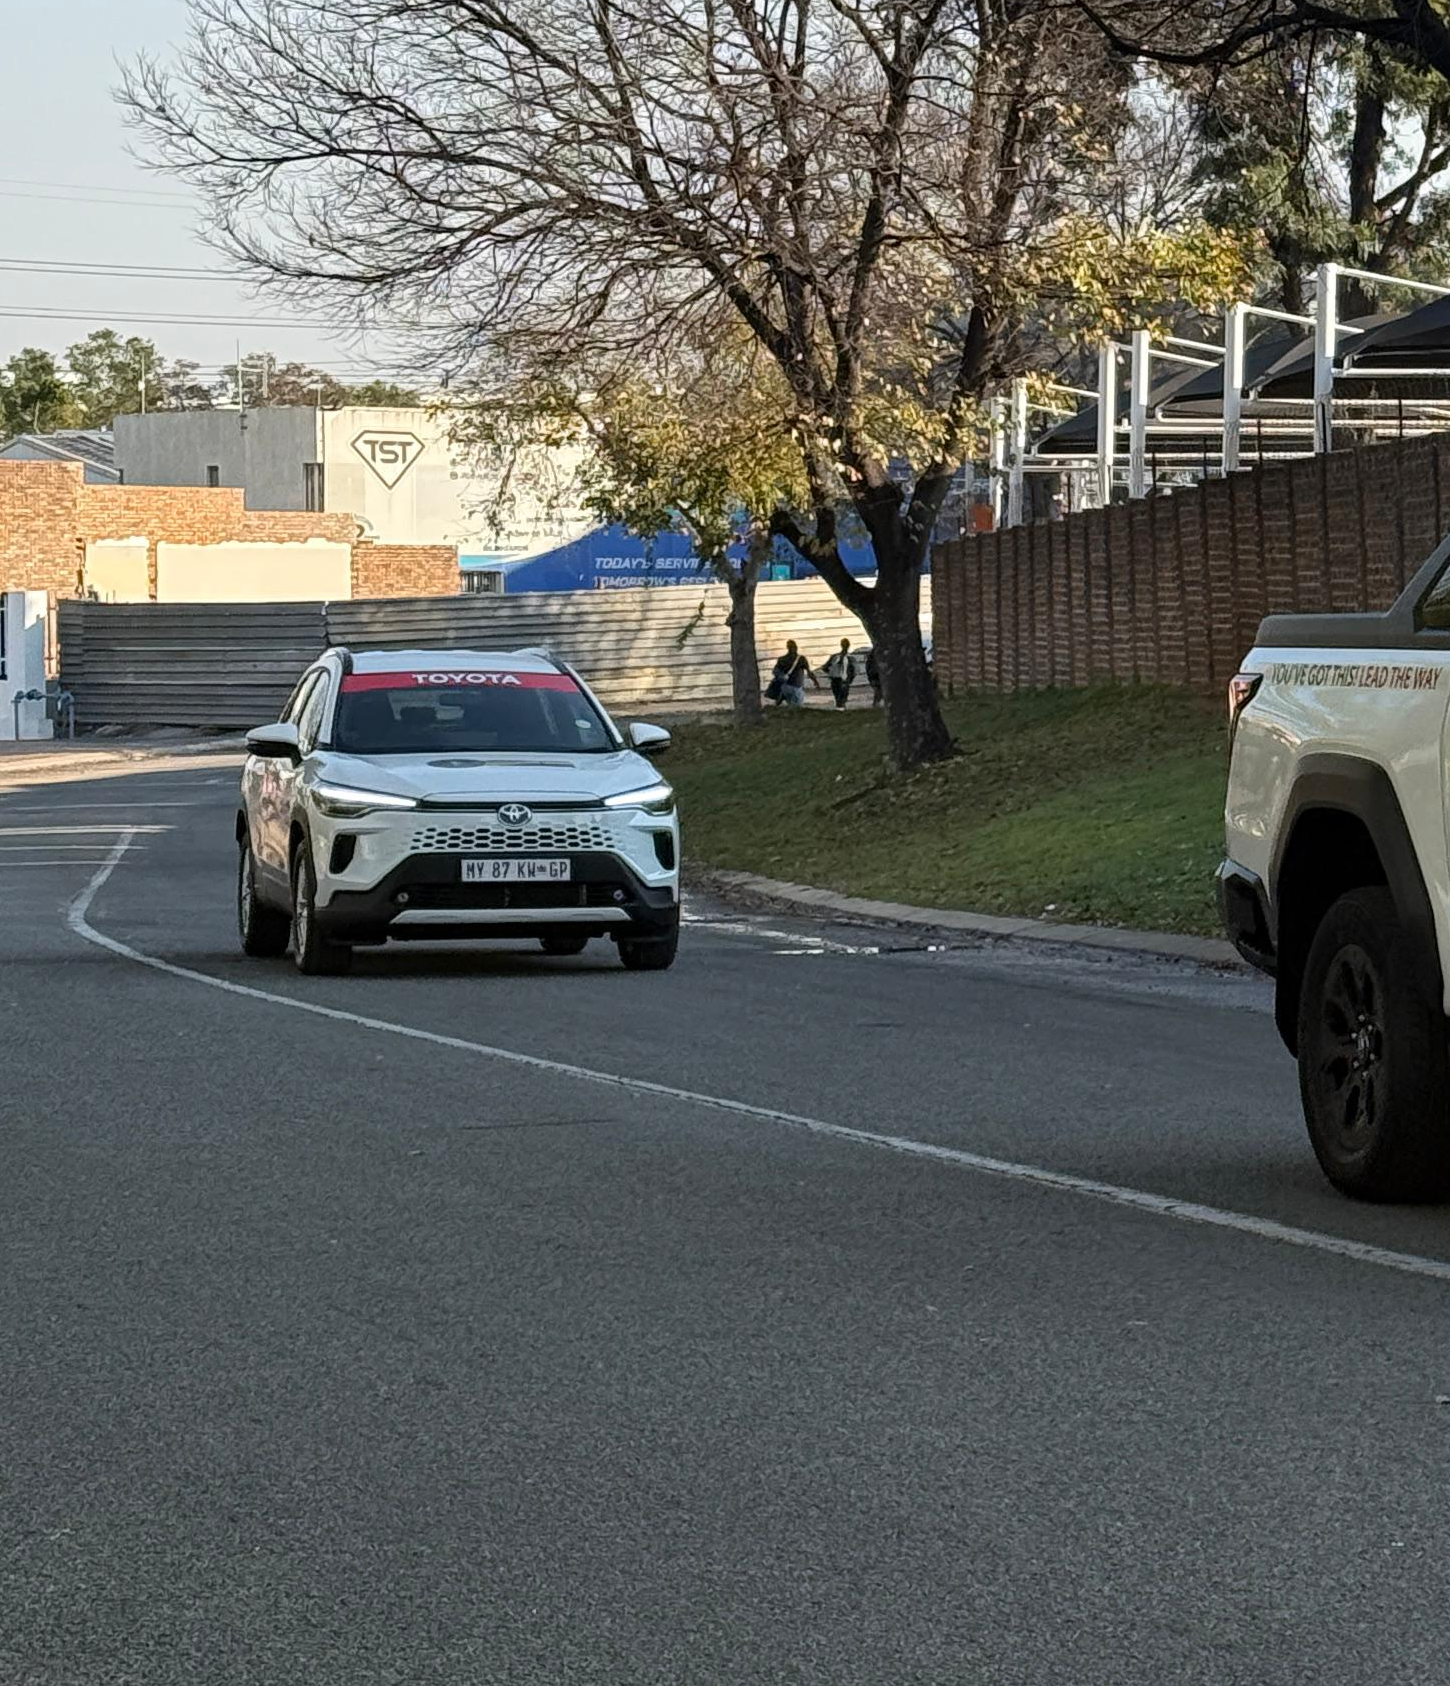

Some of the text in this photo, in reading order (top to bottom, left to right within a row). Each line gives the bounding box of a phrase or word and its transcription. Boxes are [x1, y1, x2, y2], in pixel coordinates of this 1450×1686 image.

[363, 440, 415, 464] TST
[412, 673, 521, 685] TOYOTA
[1271, 663, 1307, 686] YOU'VE
[1308, 664, 1331, 687] GOT
[1358, 665, 1388, 689] LEAD
[1389, 666, 1413, 690] THE
[1413, 667, 1442, 690] WAY
[492, 861, 511, 879] 87
[549, 861, 568, 878] GP
